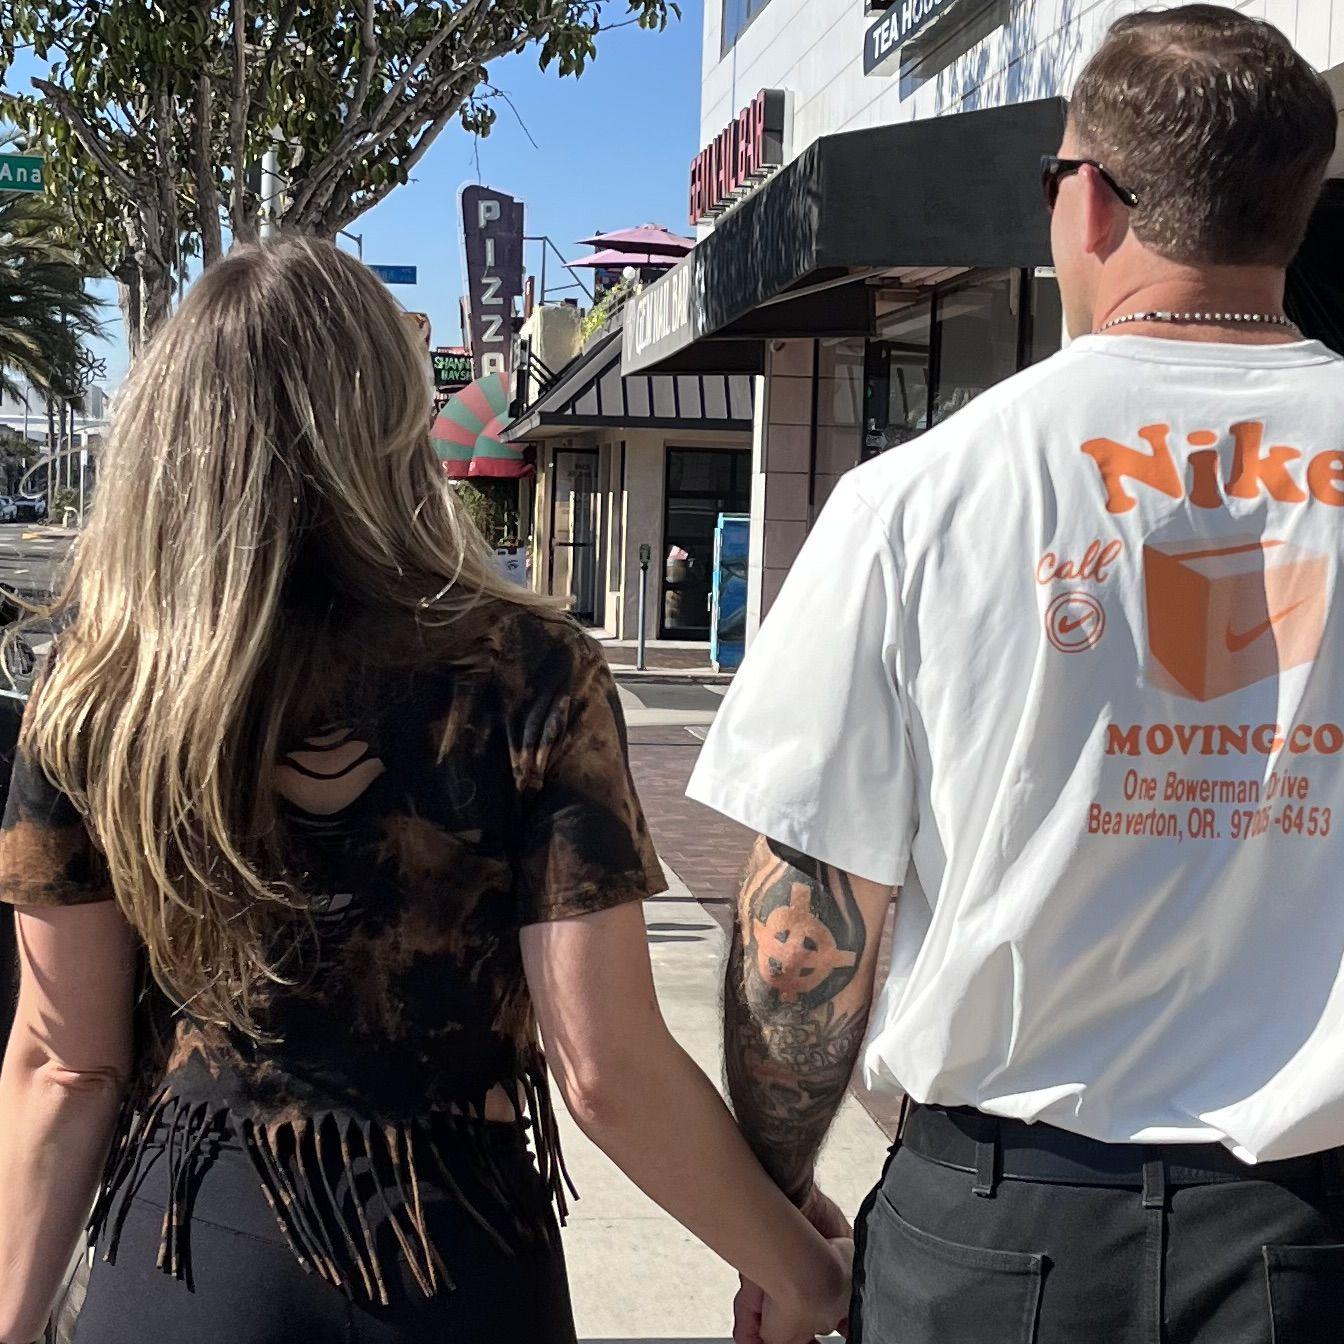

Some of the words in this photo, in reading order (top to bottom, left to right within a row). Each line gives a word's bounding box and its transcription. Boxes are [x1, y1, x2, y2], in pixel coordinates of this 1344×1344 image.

[872, 21, 900, 60] TEA
[738, 88, 766, 185] BAR
[477, 199, 505, 376] PIZZA
[672, 265, 689, 333] BAR
[1037, 539, 1122, 584] Call
[1105, 723, 1285, 757] MOVING
[1123, 768, 1157, 801] One
[1163, 772, 1260, 804] Bowerman
[1264, 768, 1310, 801] Dive
[1188, 807, 1221, 839] OR.
